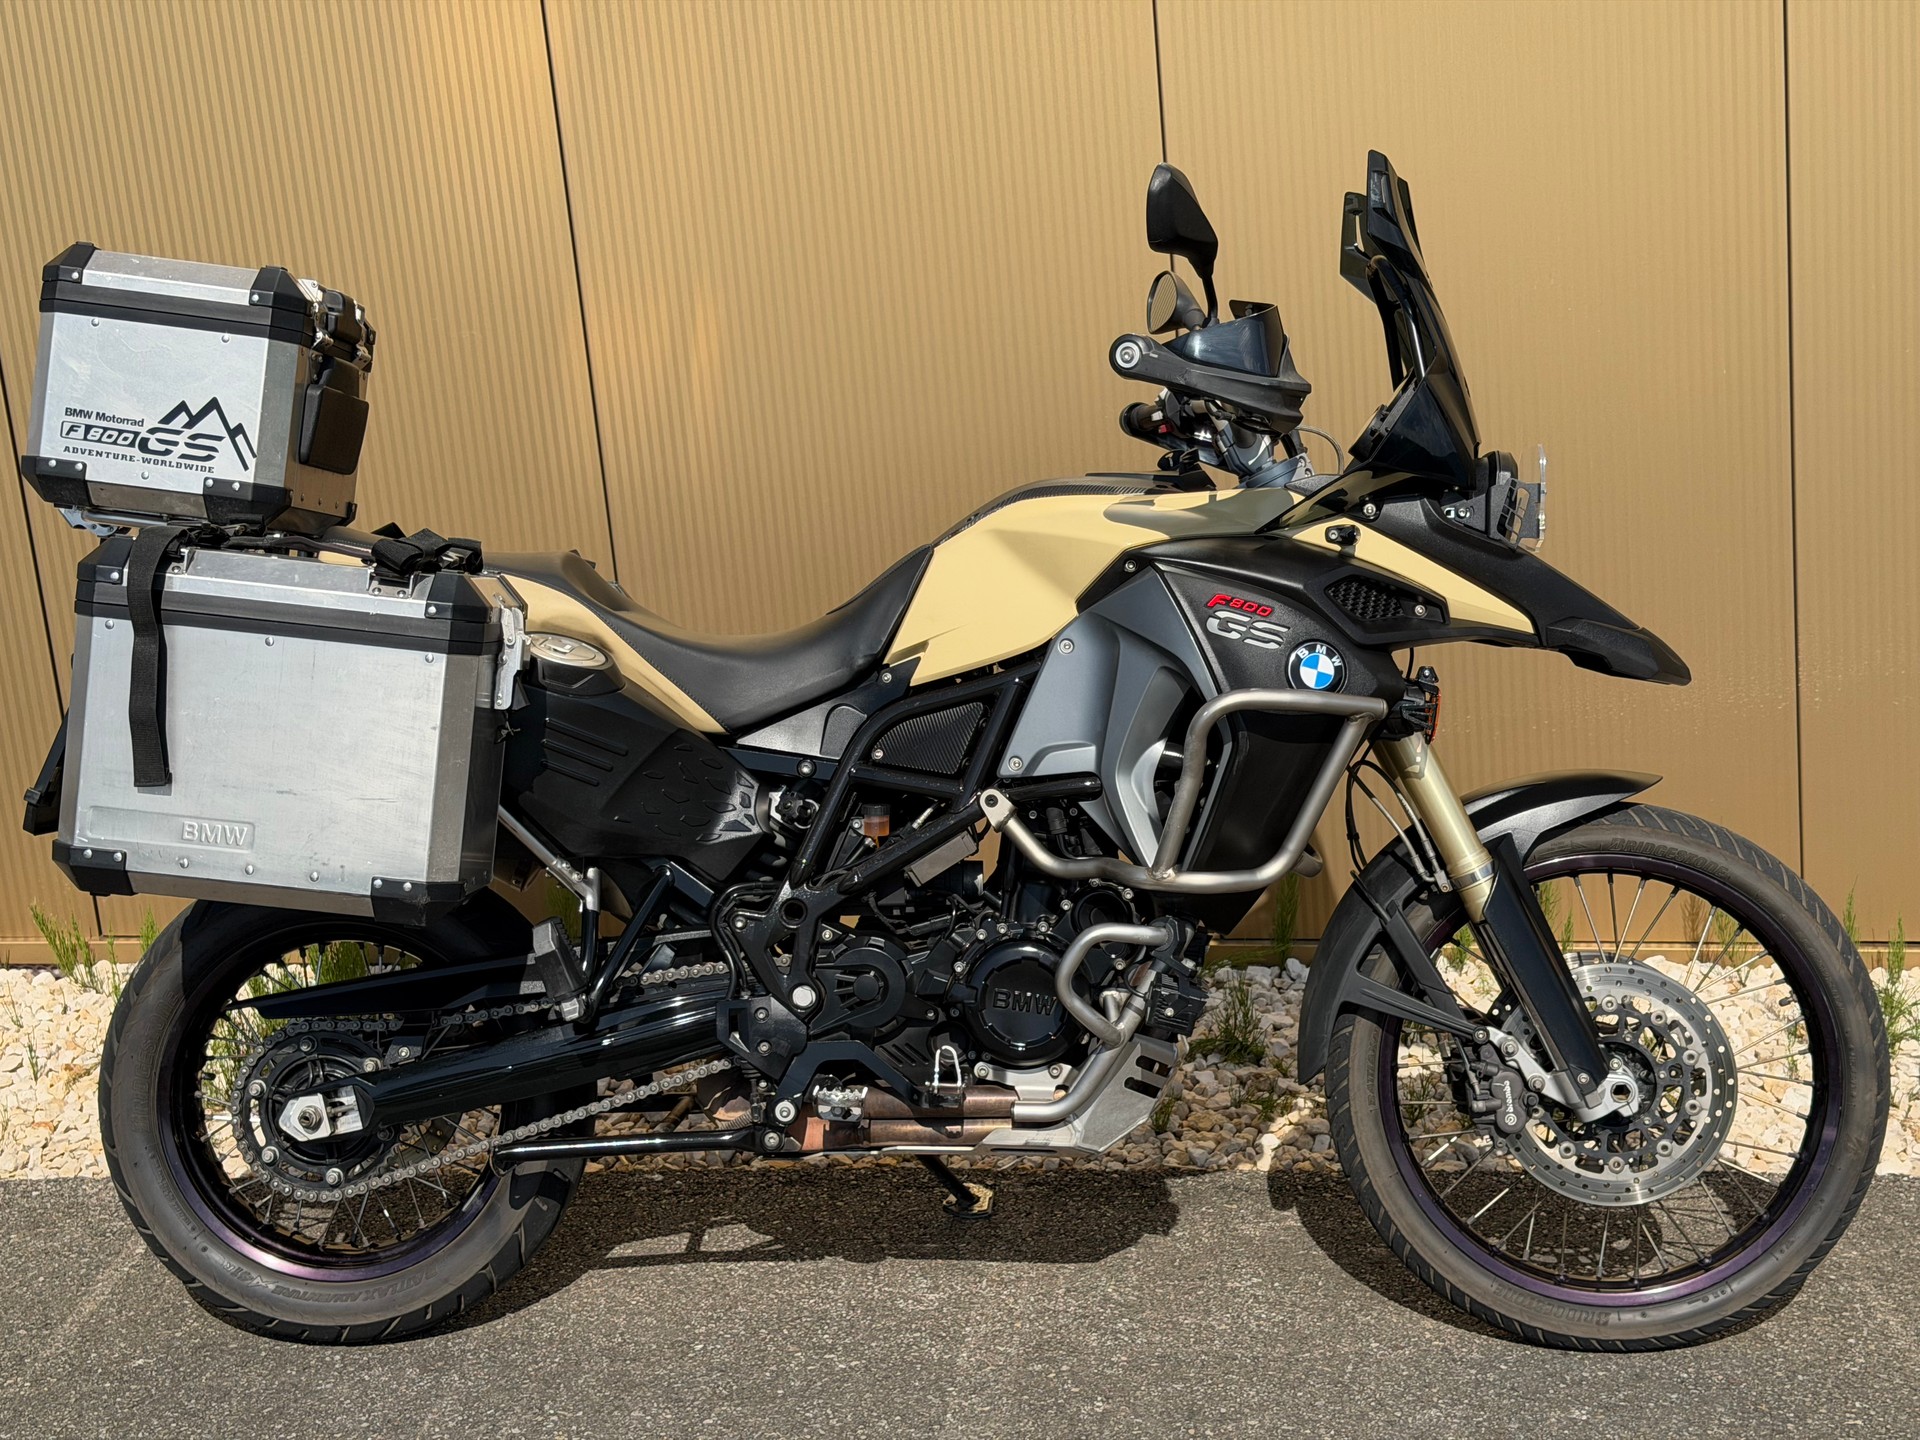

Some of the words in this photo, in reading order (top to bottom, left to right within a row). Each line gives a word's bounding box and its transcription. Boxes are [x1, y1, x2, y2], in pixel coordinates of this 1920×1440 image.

[64, 407, 93, 420] BMW
[95, 411, 145, 427] Motorrad
[65, 424, 82, 436] F
[86, 427, 135, 446] 800
[137, 427, 226, 463] GS
[1206, 593, 1274, 617] F800
[1206, 610, 1291, 650] GS
[1296, 644, 1343, 667] BMW
[182, 821, 248, 846] BMW
[1609, 838, 1730, 877] BRIDGESTONE
[993, 988, 1057, 1016] BMW
[1503, 1080, 1514, 1112] brembo
